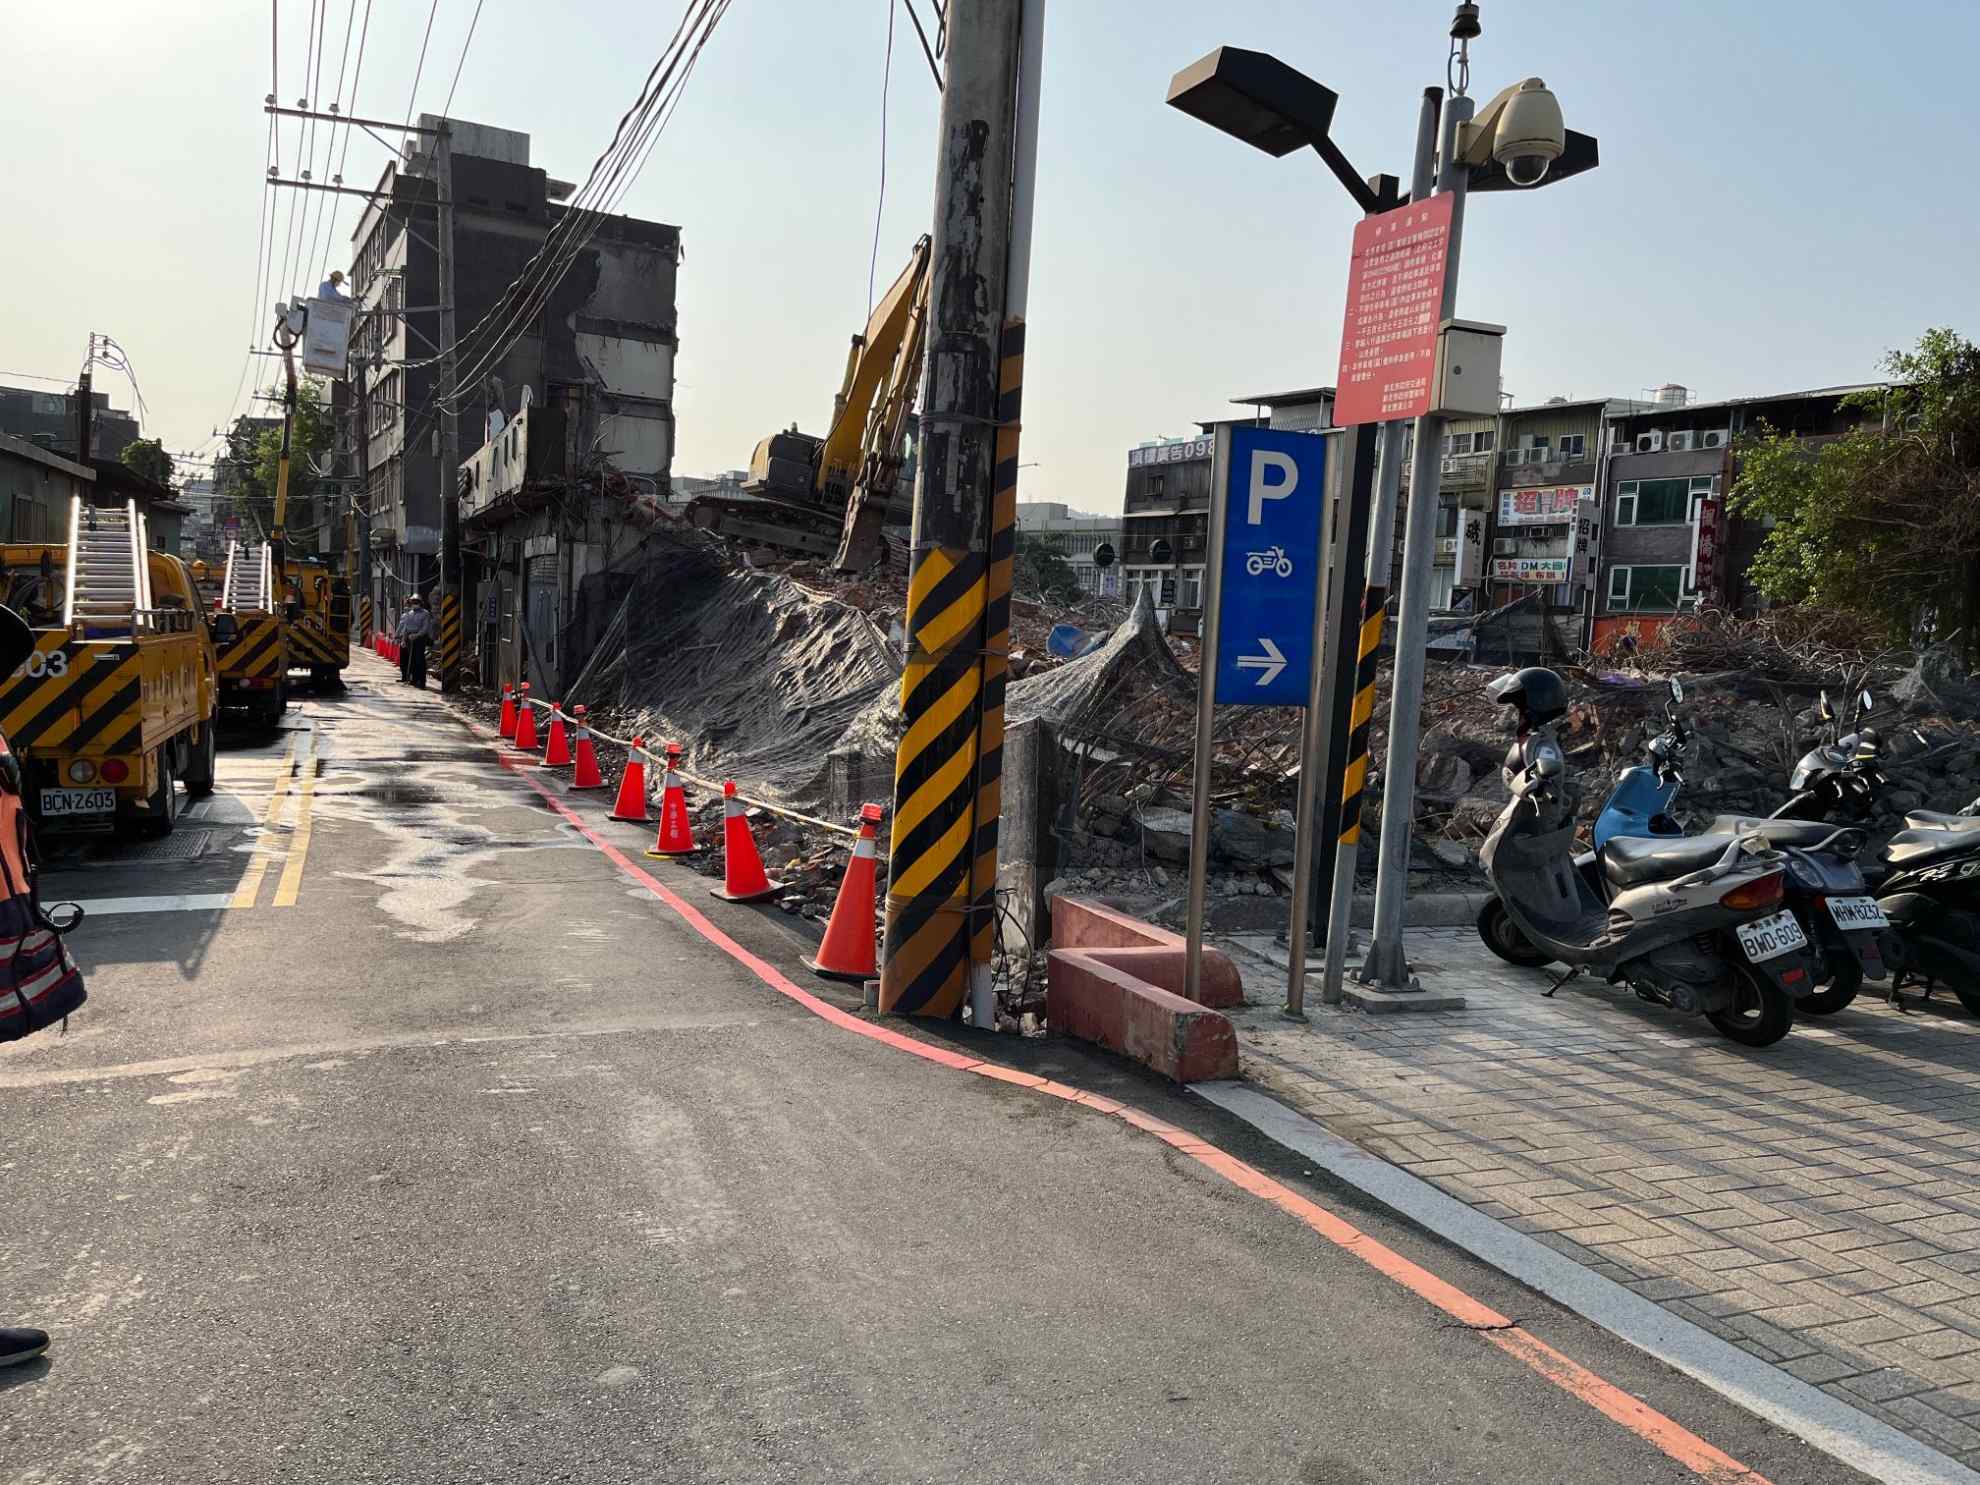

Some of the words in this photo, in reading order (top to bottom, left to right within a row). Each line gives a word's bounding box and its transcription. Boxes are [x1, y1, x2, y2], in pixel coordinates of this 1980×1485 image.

[1248, 449, 1299, 525] P
[1521, 561, 1538, 570] DM
[42, 791, 114, 812] BCN-2603
[1744, 922, 1803, 957] BWD-609
